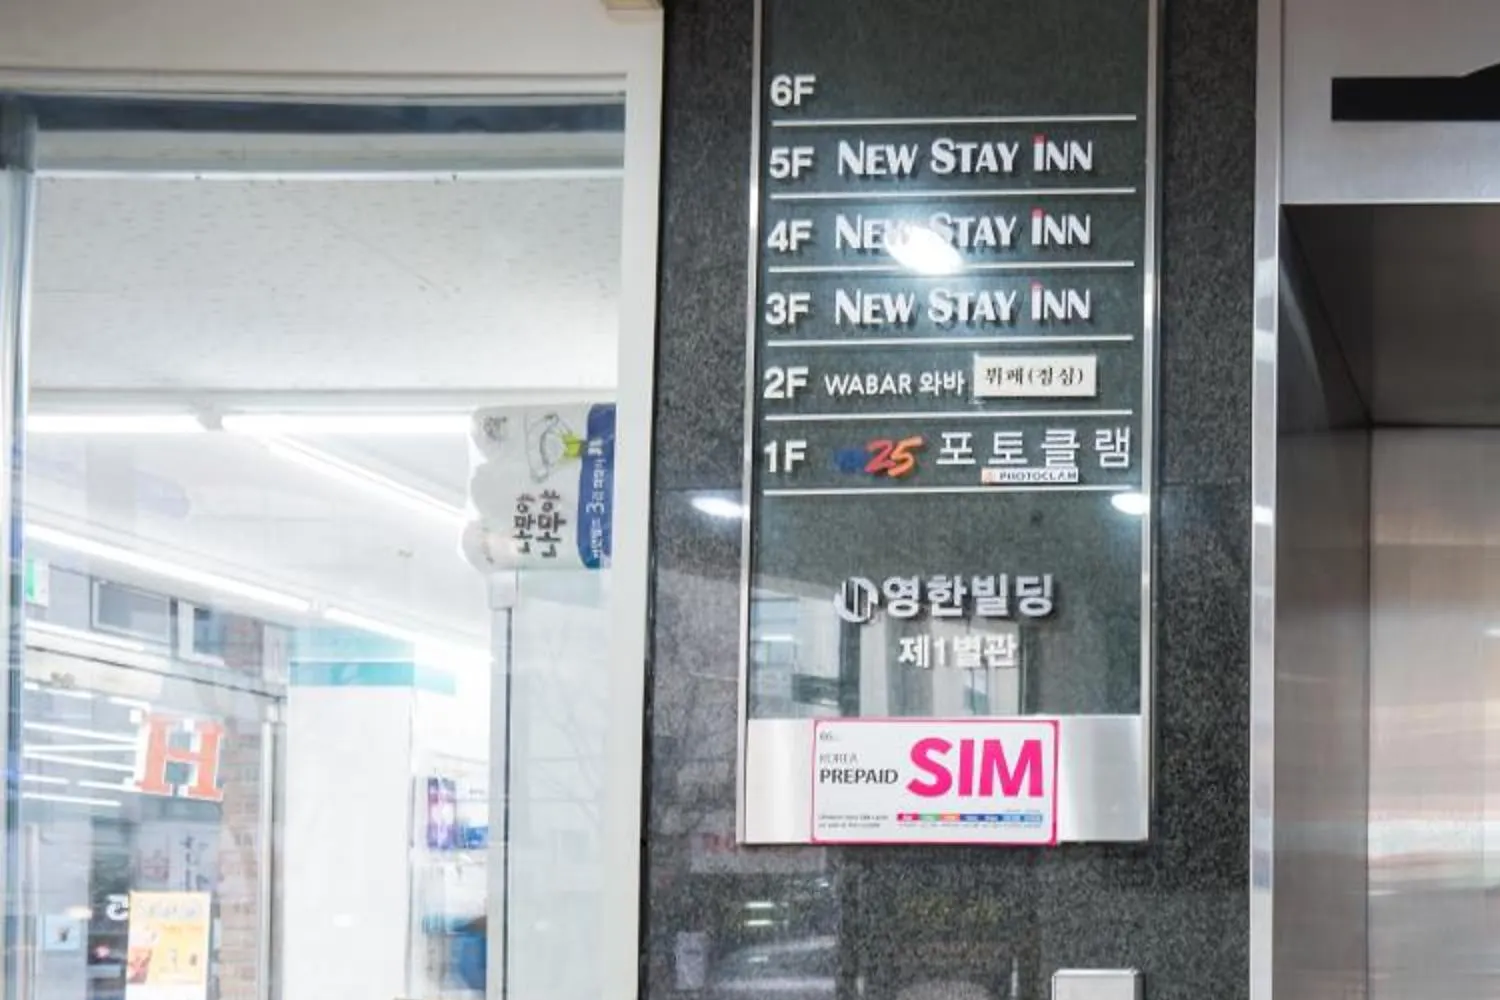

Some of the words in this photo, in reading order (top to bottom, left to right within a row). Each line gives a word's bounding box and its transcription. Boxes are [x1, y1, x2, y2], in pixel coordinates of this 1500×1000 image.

[769, 74, 816, 107] 6F
[768, 146, 815, 179] 5F
[837, 139, 918, 176] NEW
[929, 137, 1019, 174] STAY
[766, 219, 813, 252] 4F
[765, 292, 811, 325] 3F
[833, 287, 914, 325] NEW
[927, 286, 1018, 323] STAY
[762, 366, 809, 400] 2F
[824, 373, 912, 397] WABAR
[919, 369, 965, 397] 와바
[763, 440, 807, 473] 1F
[936, 427, 1131, 469] 포토클램
[538, 490, 567, 559] 나무야
[882, 573, 1054, 617] 영한빌딩
[897, 633, 1018, 669] 제1별관
[818, 768, 899, 786] PREPAID
[906, 737, 1044, 799] SIM
